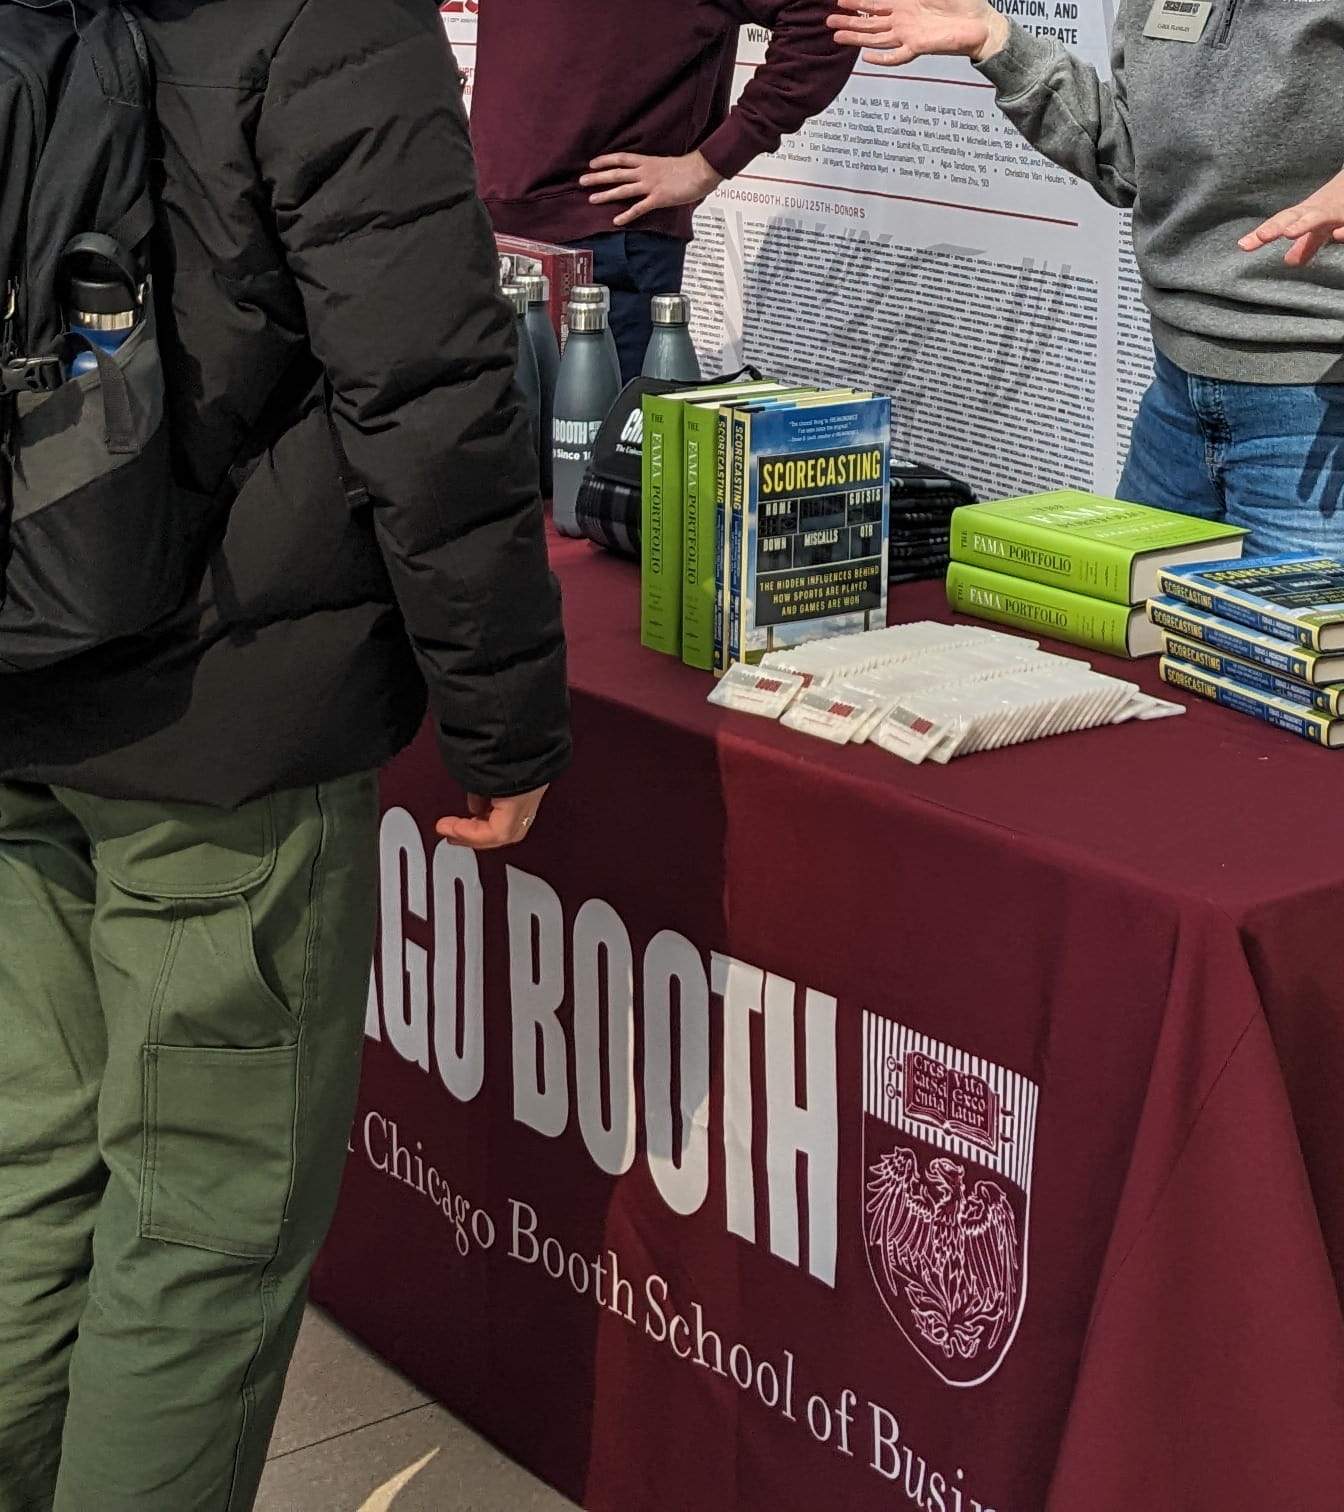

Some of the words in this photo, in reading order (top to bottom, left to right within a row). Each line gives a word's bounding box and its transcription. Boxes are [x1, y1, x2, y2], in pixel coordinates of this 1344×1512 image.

[1054, 2, 1078, 20] AND
[747, 27, 770, 43] WHA
[714, 188, 866, 219] CHICAGOBOOTH.EDU/125TH-DONORS
[717, 418, 728, 505] SCORECASTING
[733, 425, 744, 511] SCORECASTING
[762, 449, 882, 494] SCORECASTING
[765, 500, 792, 517] HOME
[849, 488, 881, 506] GUESTS
[651, 485, 663, 575] PORTFOLIO
[687, 491, 699, 586] PORTFOLIO
[763, 536, 787, 552] DOWN
[804, 529, 839, 547] MISCALLS
[973, 534, 1006, 557] FAMA
[1008, 544, 1072, 573] PORTFOLIO
[760, 581, 774, 592] THE
[776, 577, 805, 590] HIDDEN
[807, 569, 852, 586] INFLUENCES
[854, 565, 880, 578] BEHIND
[773, 593, 791, 604] HOW
[793, 588, 823, 600] SPORTS
[825, 585, 840, 597] ARE
[841, 580, 868, 593] PLAYED
[1163, 579, 1213, 608] SCORECASTING
[781, 605, 797, 617] AND
[799, 600, 825, 614] GAMES
[827, 598, 841, 609] ARE
[843, 594, 860, 606] WON
[969, 587, 1002, 610] FAMA
[1004, 597, 1068, 627] PORTFOLIO
[1153, 609, 1204, 639] SCORECASTING
[1169, 641, 1222, 672] SCORECASTING
[1167, 668, 1217, 700] SCORECASTING
[506, 863, 838, 1290] BOOTH
[954, 1072, 984, 1097] Vita
[951, 1100, 986, 1128] latur
[363, 1108, 496, 1257] Chicago
[507, 1197, 639, 1328] Booth
[644, 1273, 796, 1425] School
[806, 1388, 858, 1458] of
[867, 1400, 997, 1512] Busi
